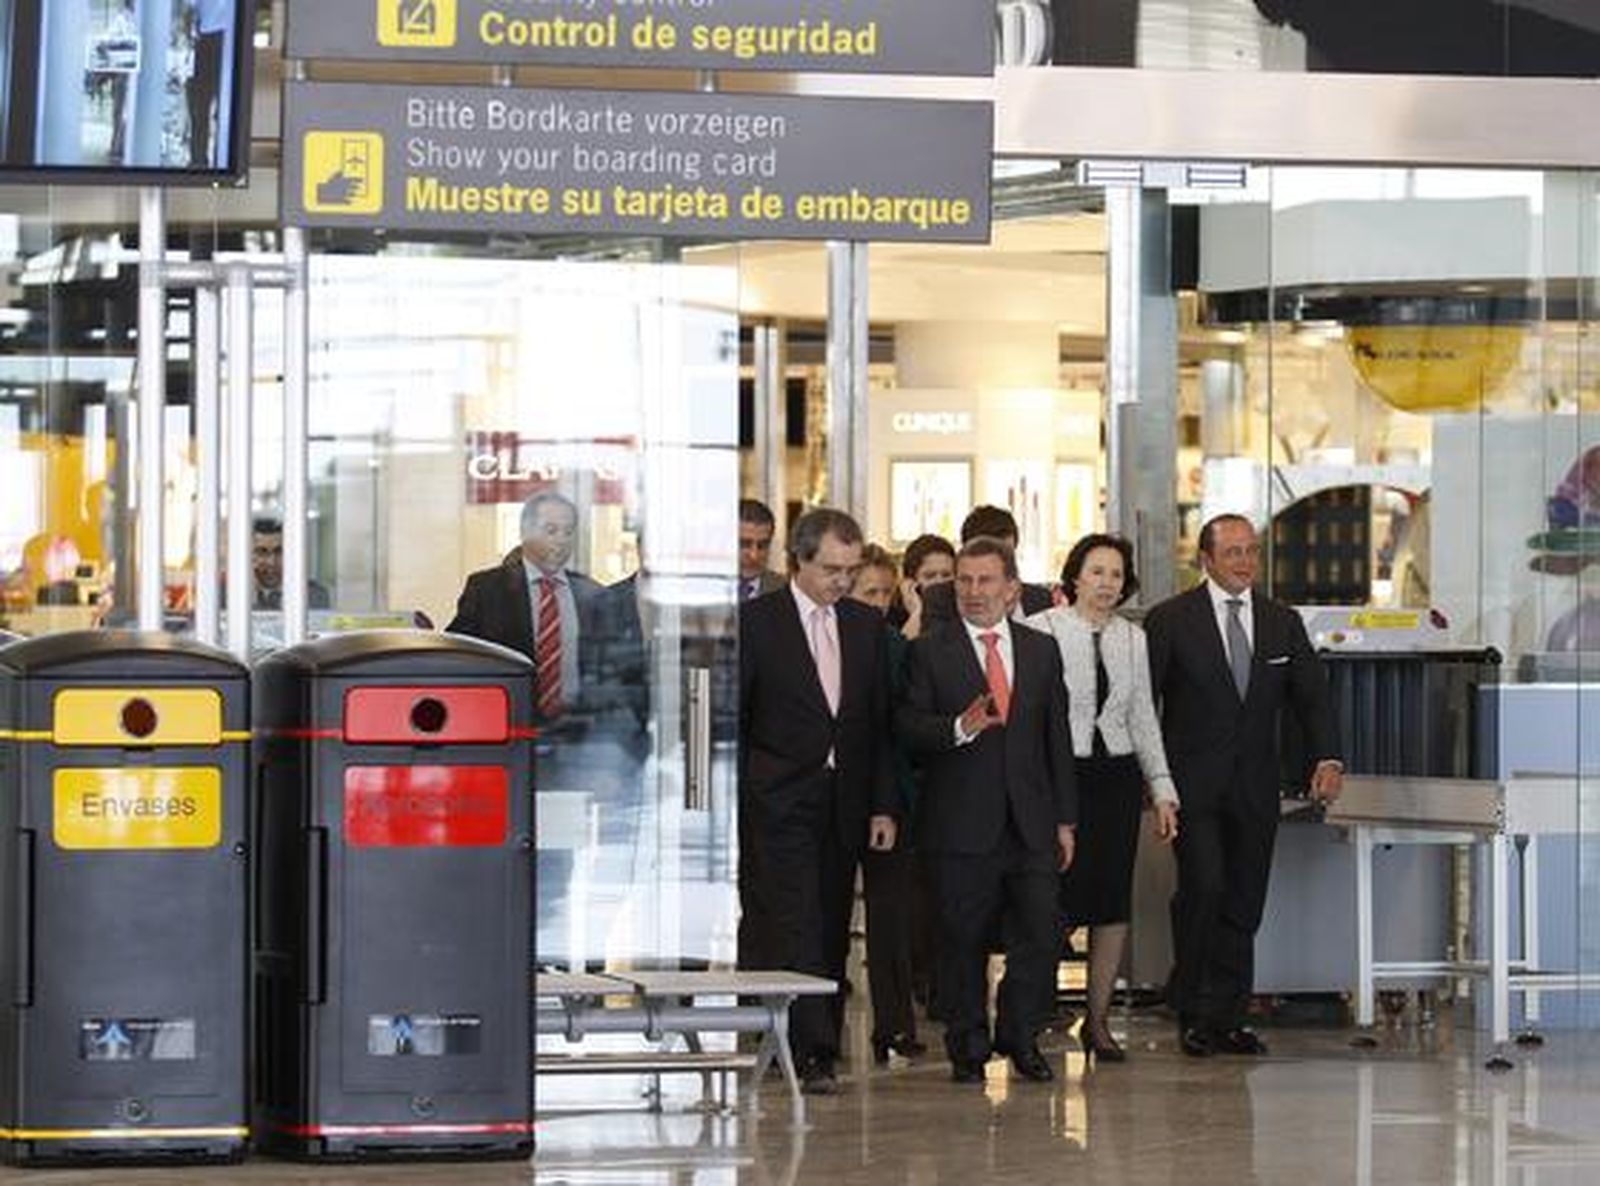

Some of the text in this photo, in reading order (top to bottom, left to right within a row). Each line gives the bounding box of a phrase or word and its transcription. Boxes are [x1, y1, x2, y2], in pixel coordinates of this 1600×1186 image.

[479, 11, 877, 58] Control de seguridad
[406, 99, 787, 143] Bitte Bordkarte vorzeigen
[406, 138, 777, 177] Show your boarding card
[406, 177, 971, 230] Muestre su tarjeta de embarque
[82, 792, 197, 817] Envases
